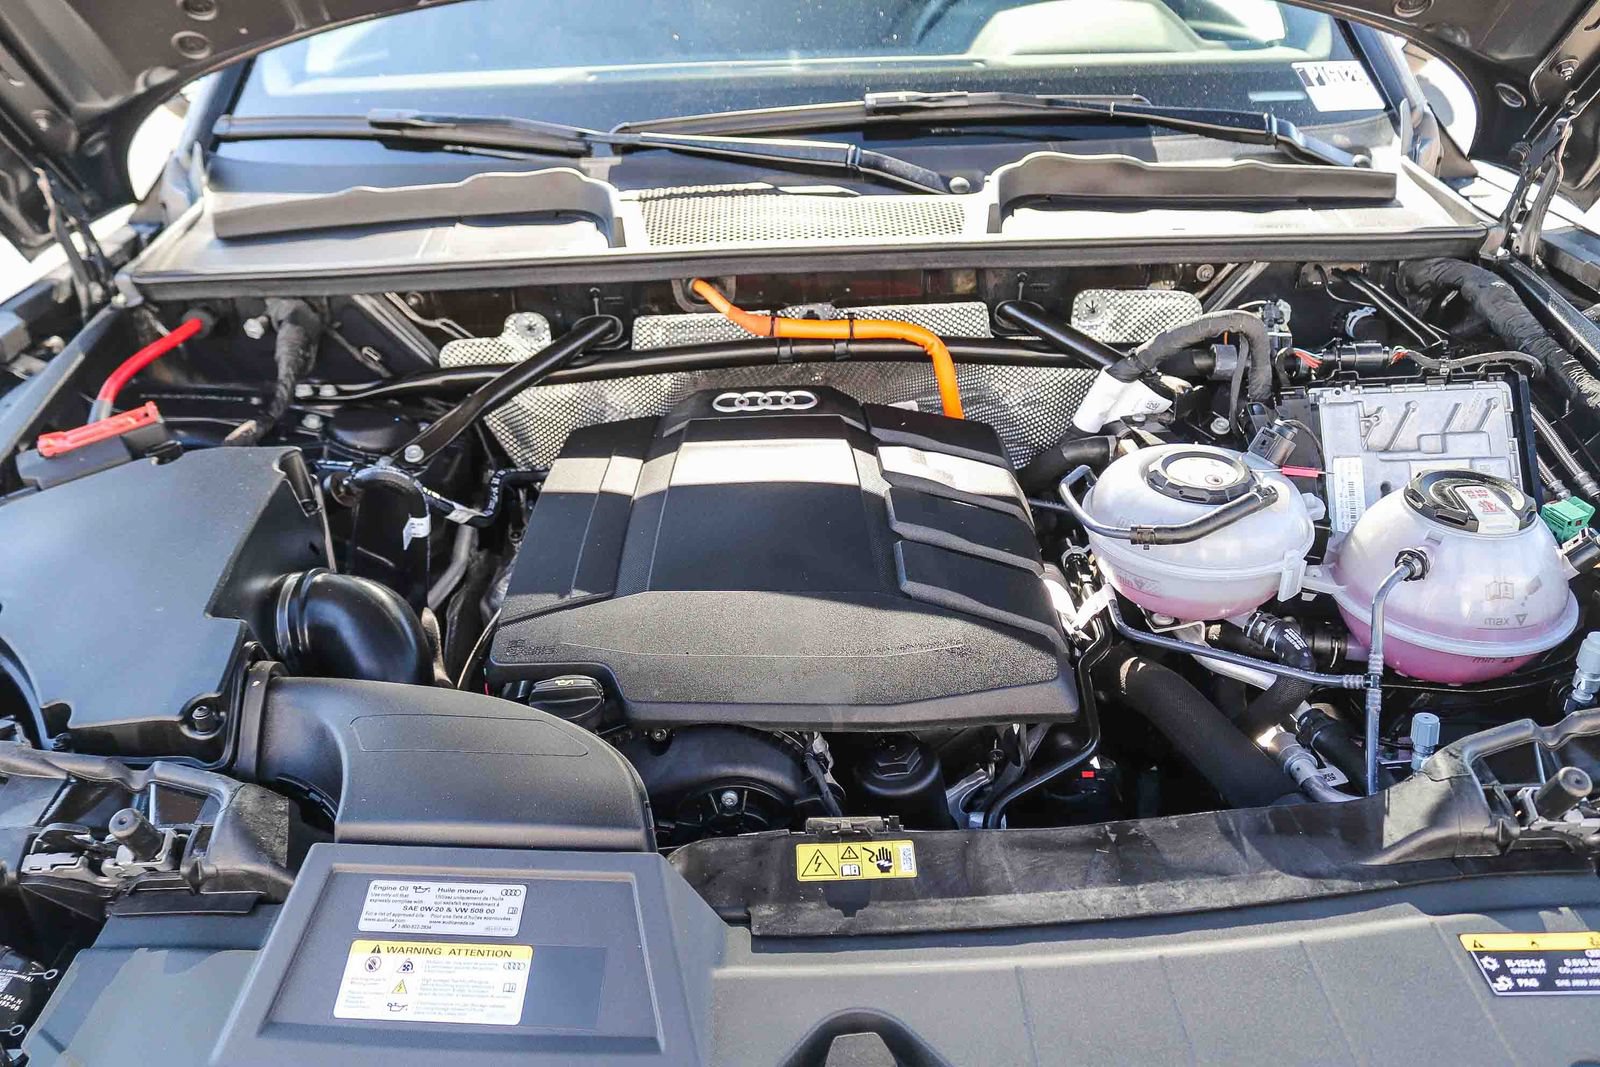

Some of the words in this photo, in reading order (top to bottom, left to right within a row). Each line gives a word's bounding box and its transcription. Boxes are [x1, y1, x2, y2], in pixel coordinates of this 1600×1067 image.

[1484, 617, 1510, 626] max
[386, 946, 442, 955] WARNING
[448, 948, 512, 957] ATTENTION
